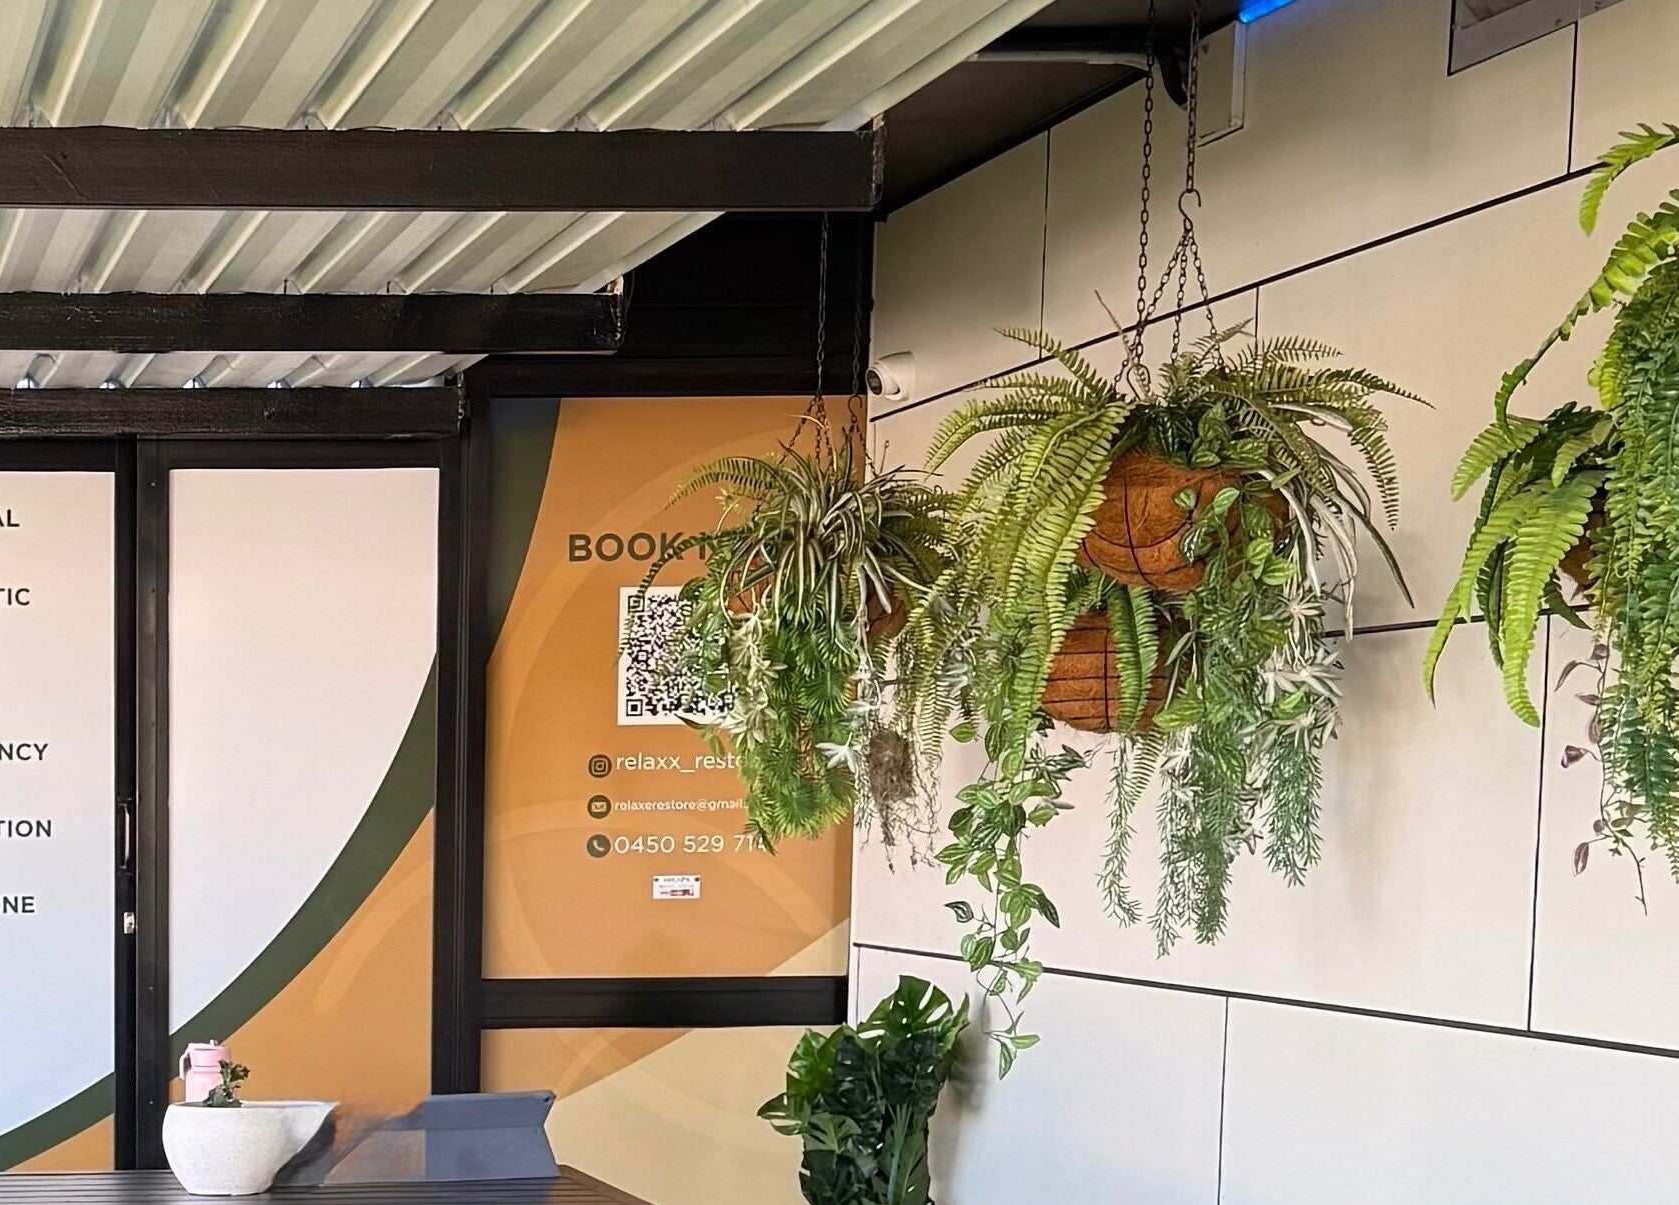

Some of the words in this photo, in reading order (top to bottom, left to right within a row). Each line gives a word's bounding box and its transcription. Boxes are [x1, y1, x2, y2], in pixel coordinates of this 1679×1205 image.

[569, 532, 684, 562] BOOK
[614, 836, 675, 854] 0450
[683, 835, 725, 853] 529
